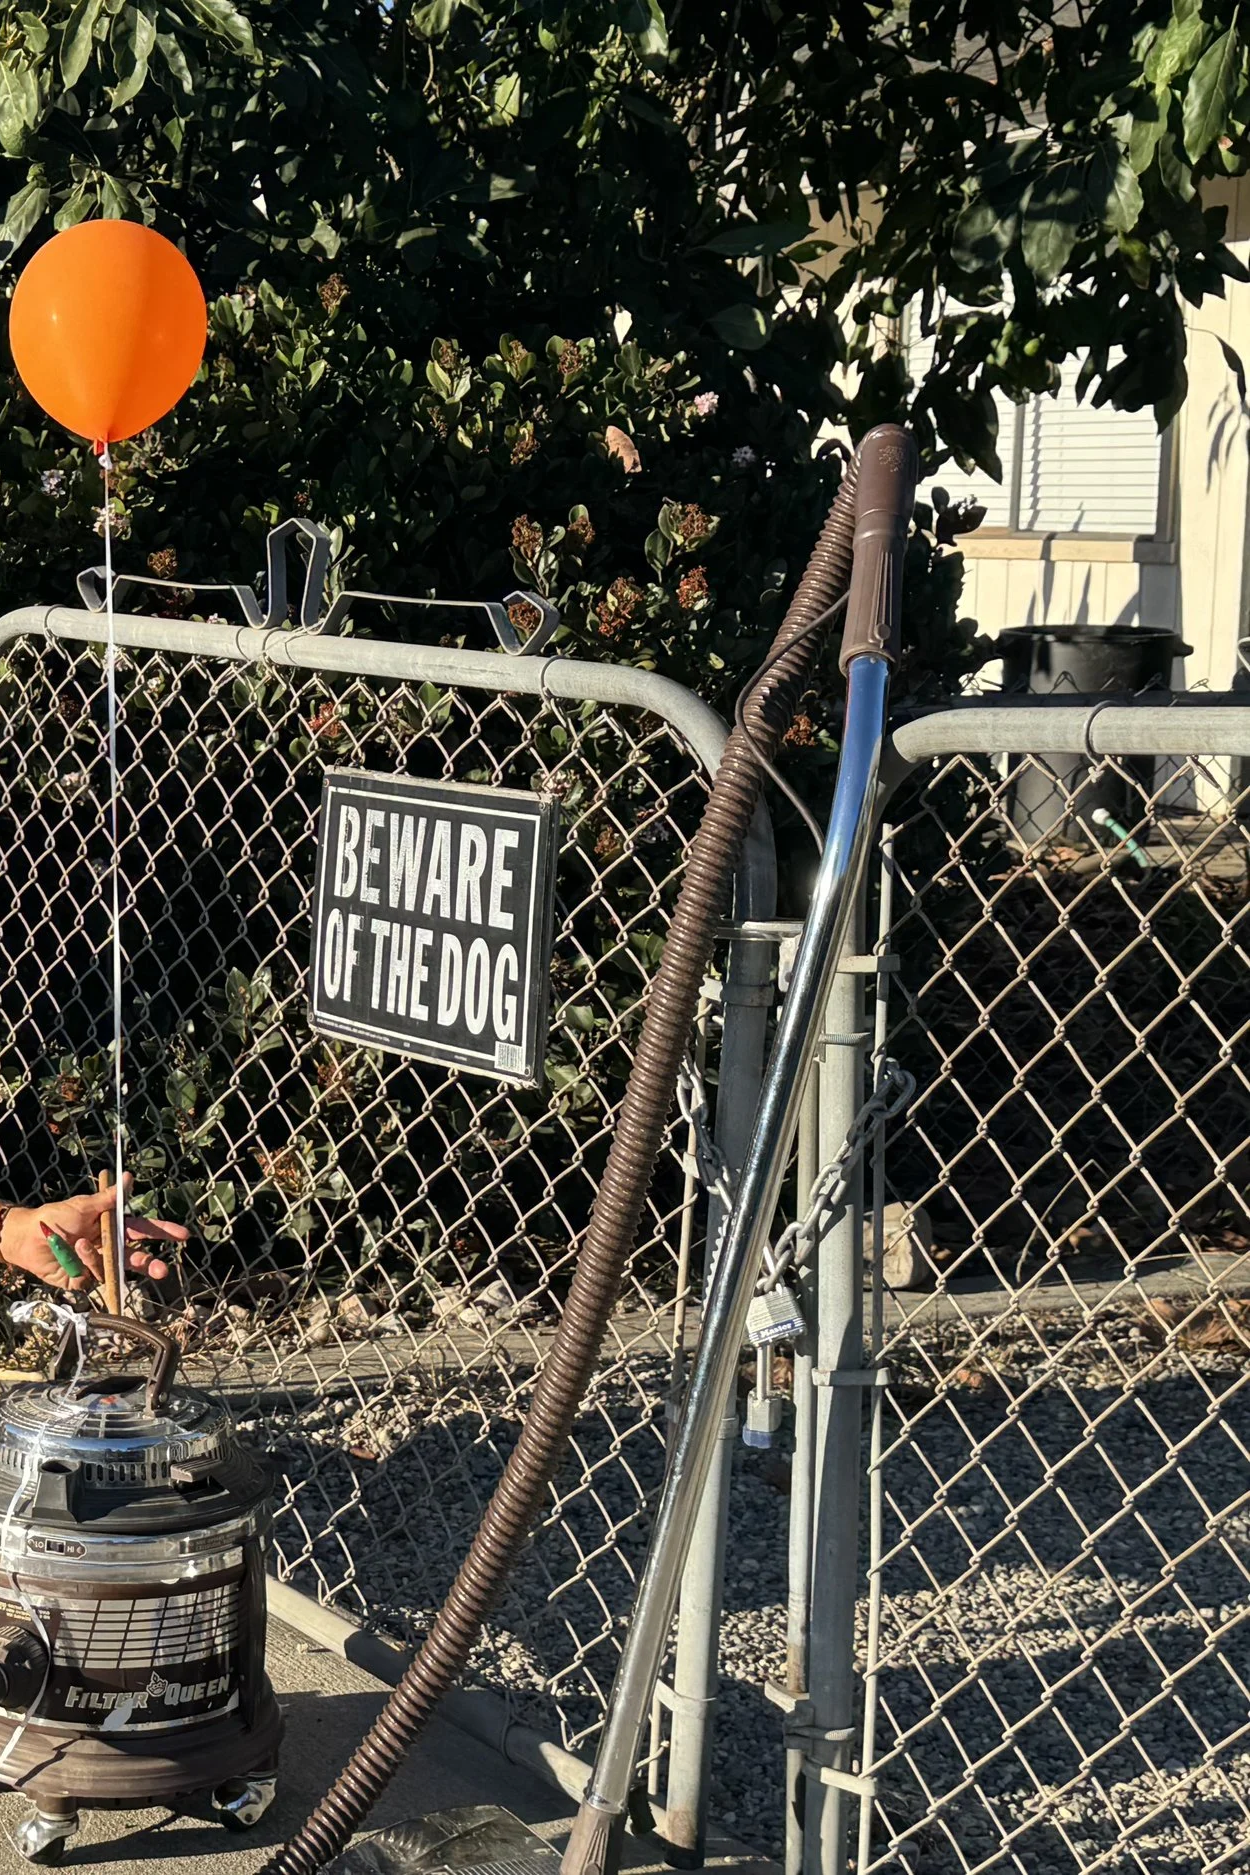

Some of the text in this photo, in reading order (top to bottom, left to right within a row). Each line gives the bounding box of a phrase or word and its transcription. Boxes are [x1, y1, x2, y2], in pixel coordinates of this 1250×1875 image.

[334, 805, 519, 930] BEWARE
[323, 908, 519, 1042] OF THE DOG
[64, 1673, 230, 1710] FILTER QUEEN
